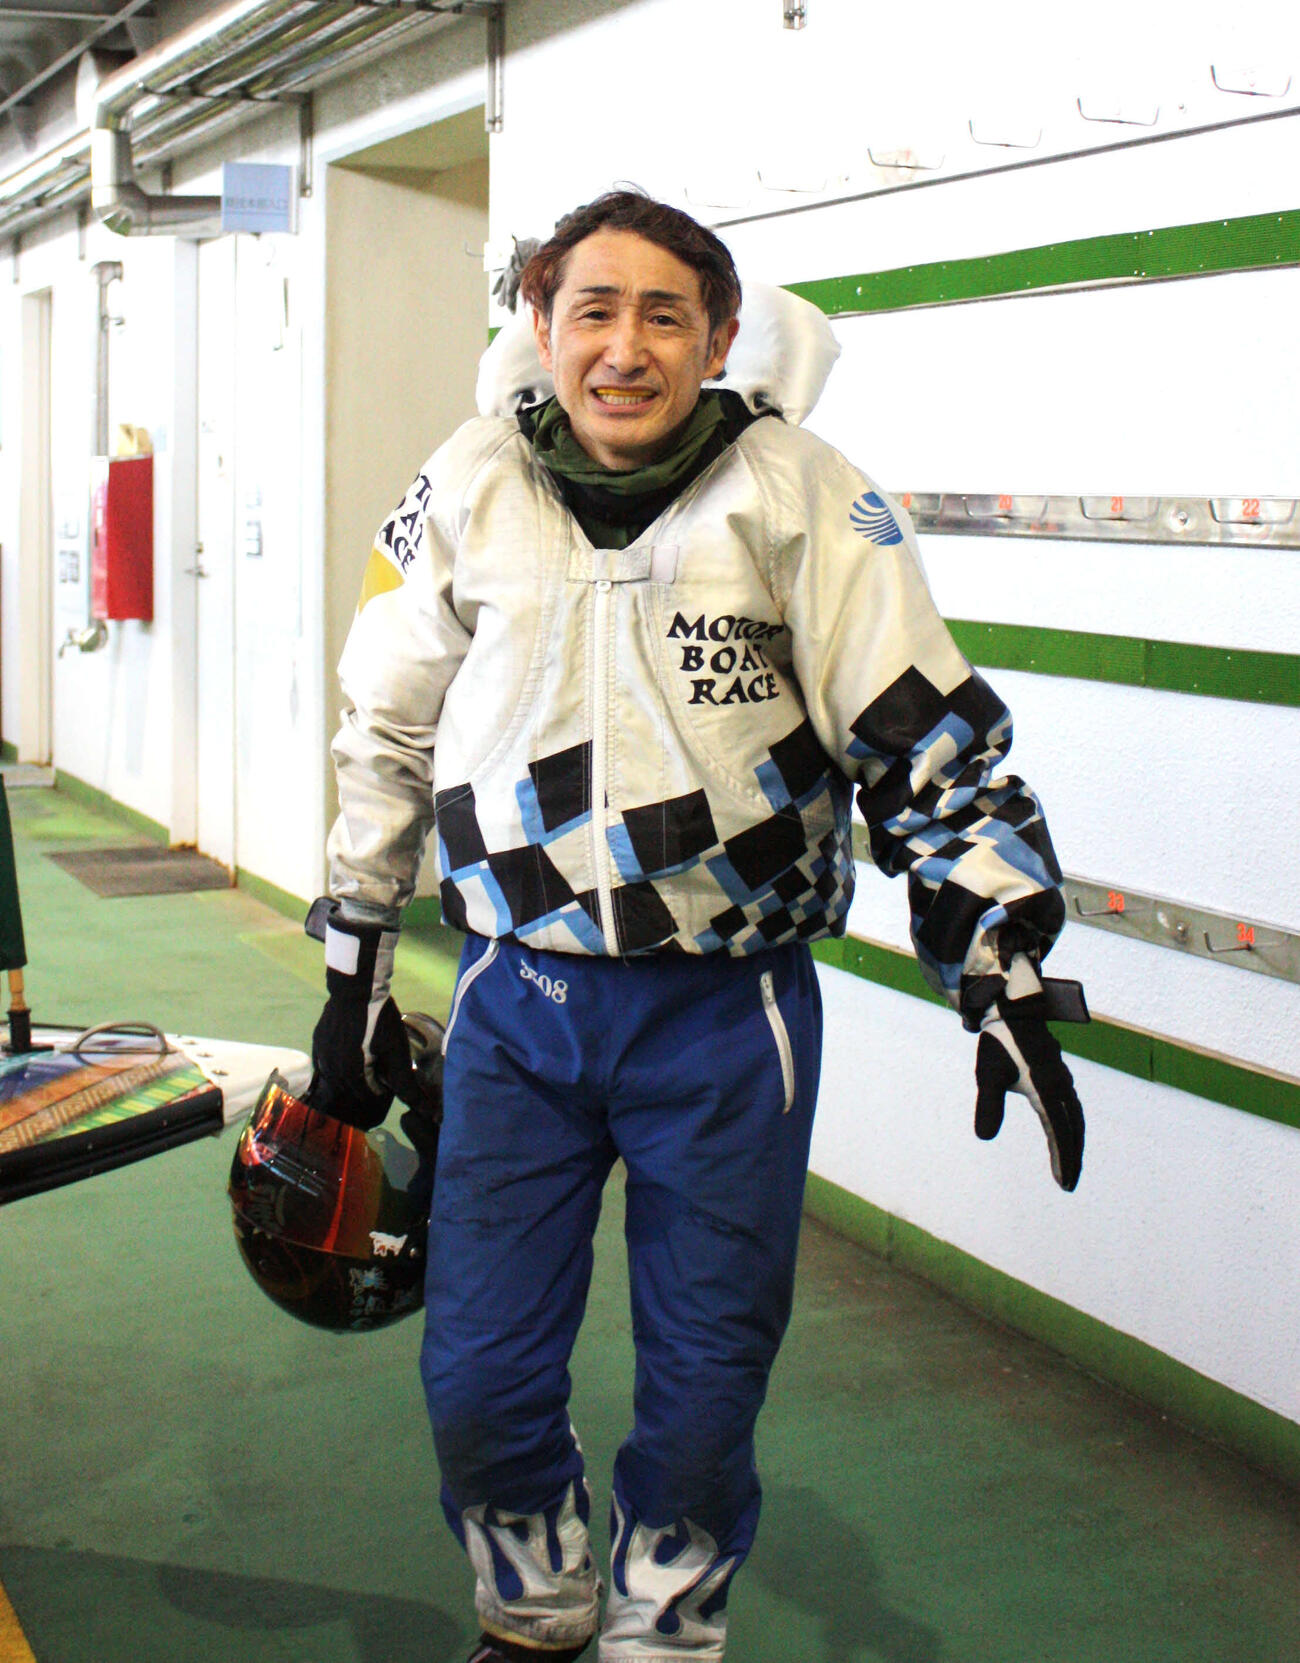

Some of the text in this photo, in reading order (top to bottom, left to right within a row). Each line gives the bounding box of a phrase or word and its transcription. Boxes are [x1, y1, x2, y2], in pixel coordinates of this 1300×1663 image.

[1111, 497, 1124, 513] 21
[1242, 498, 1260, 518] 22
[379, 520, 416, 575] ACE
[687, 672, 781, 705] RACE
[1108, 890, 1125, 912] 33
[1236, 922, 1257, 945] 34
